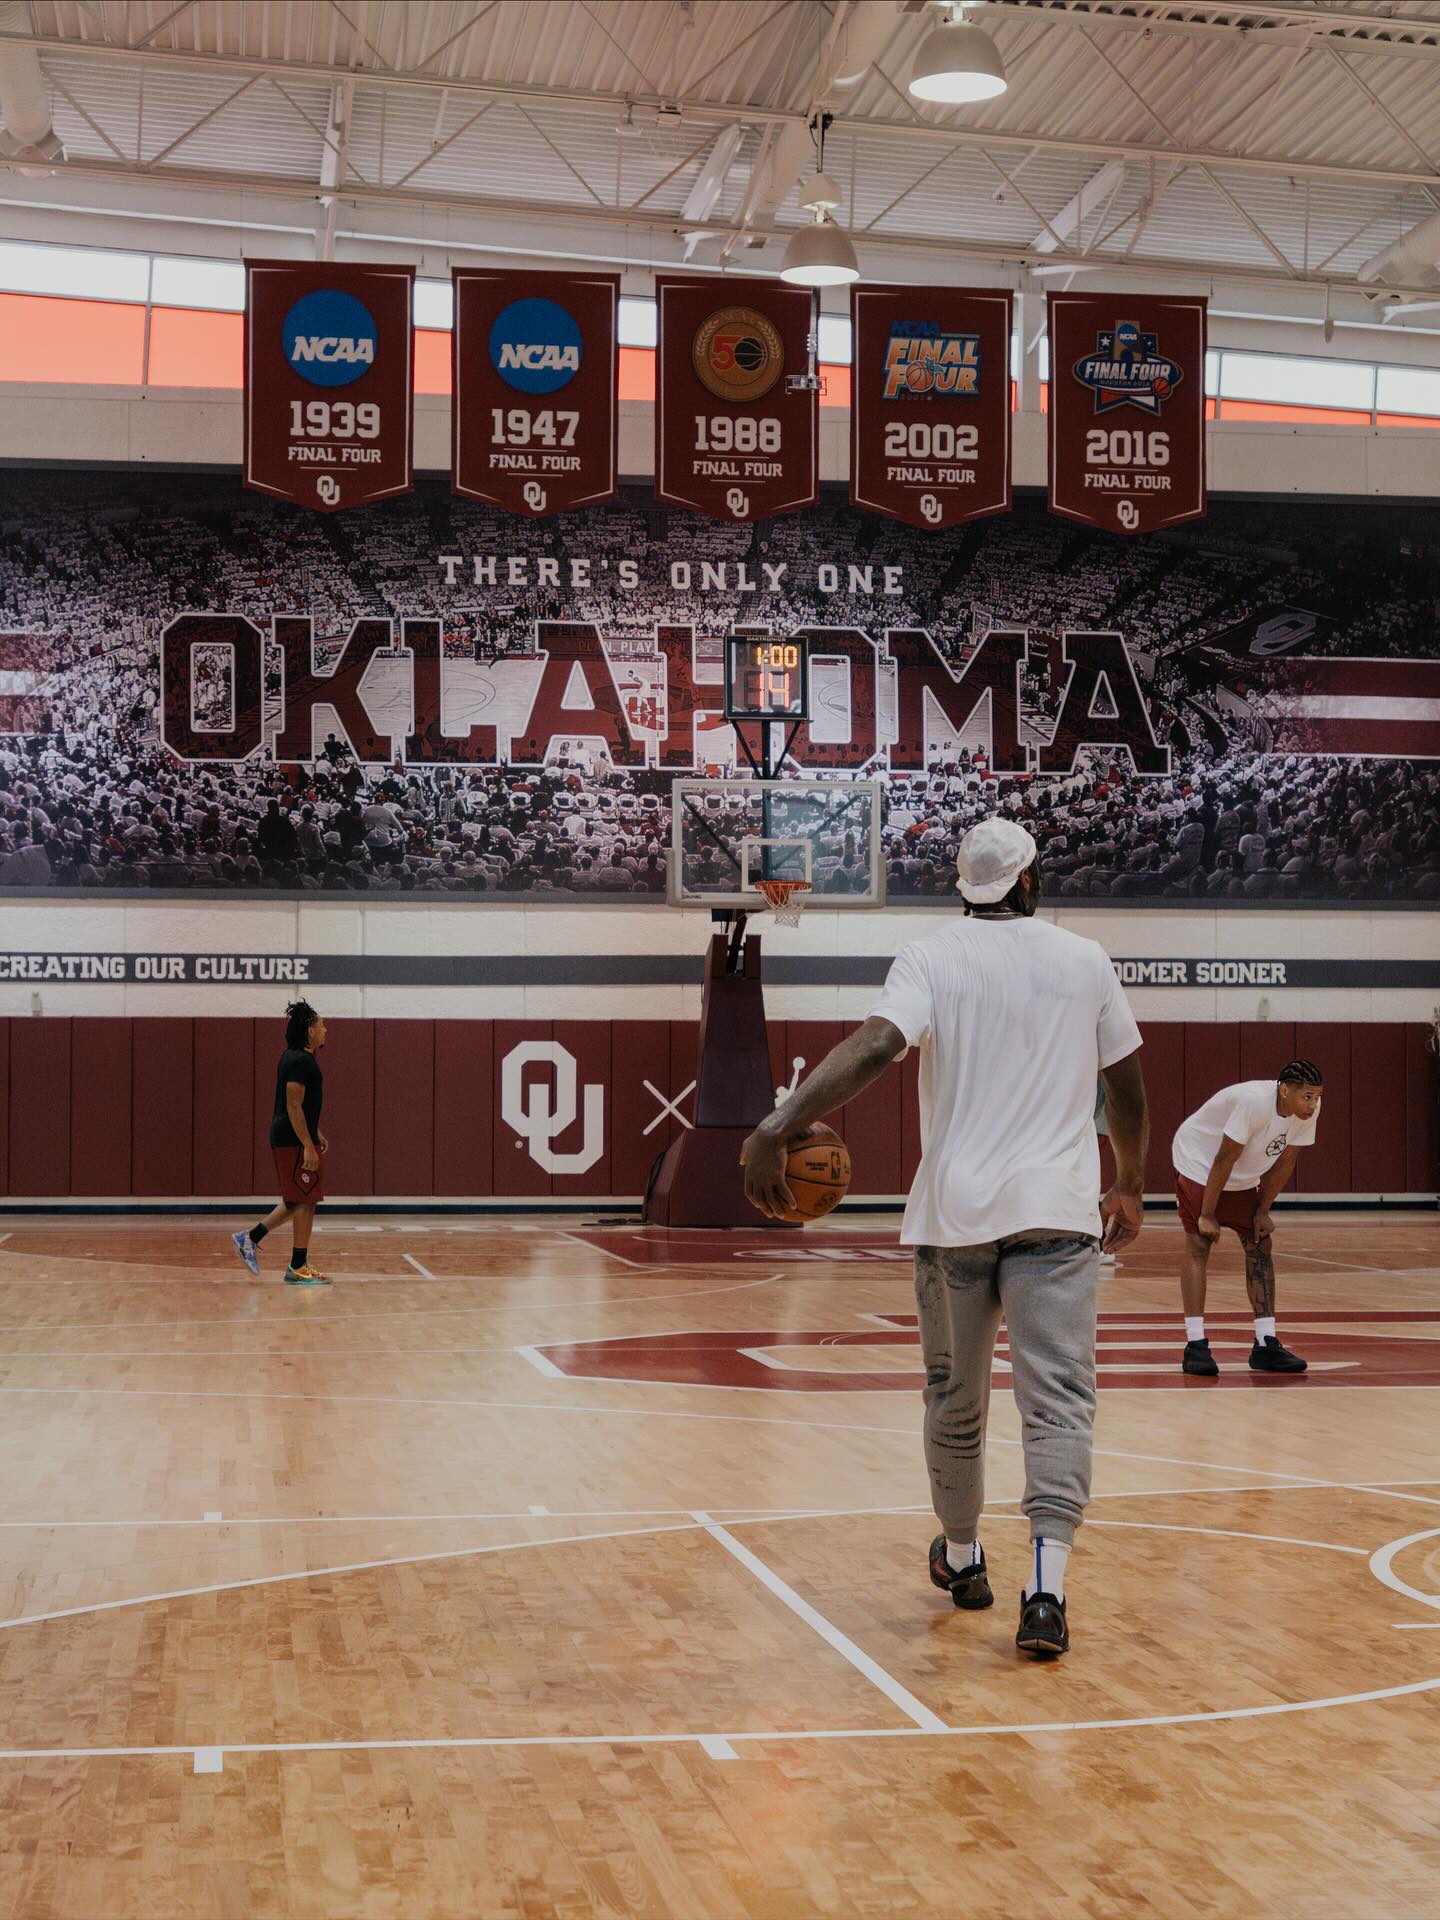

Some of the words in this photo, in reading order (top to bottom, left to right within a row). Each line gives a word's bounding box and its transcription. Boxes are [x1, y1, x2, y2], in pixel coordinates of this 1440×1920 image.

[291, 335, 375, 364] NCAA
[498, 343, 580, 371] NCAA
[884, 338, 979, 370] FINAL
[1084, 361, 1128, 379] FINAL
[1129, 362, 1171, 380] FOUR
[289, 400, 381, 439] 1939
[491, 408, 580, 446] 1947
[695, 415, 782, 453] 1988
[288, 446, 336, 462] FINAL
[341, 448, 381, 464] FOUR
[884, 422, 979, 460] 2002
[1086, 429, 1170, 466] 2016
[489, 454, 536, 470] FINAL
[541, 456, 581, 470] FOUR
[692, 460, 740, 476] FINAL
[744, 462, 783, 477] FOUR
[886, 466, 933, 482] FINAL
[938, 468, 976, 483] FOUR
[316, 475, 340, 505] OU
[523, 481, 546, 511] OU
[1084, 473, 1130, 488] FINAL
[1134, 475, 1171, 490] FOUR
[726, 487, 749, 518] OU
[920, 494, 942, 523] OU
[1116, 500, 1139, 529] OU
[438, 555, 640, 590] THERE'S
[670, 561, 788, 592] ONLY
[817, 564, 904, 595] ONE
[757, 645, 798, 668] 1:00
[759, 672, 790, 710] 14
[0, 956, 126, 979] CREATING
[135, 957, 186, 979] OUR
[195, 958, 309, 980] CULTURE
[1196, 962, 1287, 983] SOONER
[502, 1041, 604, 1174] OU
